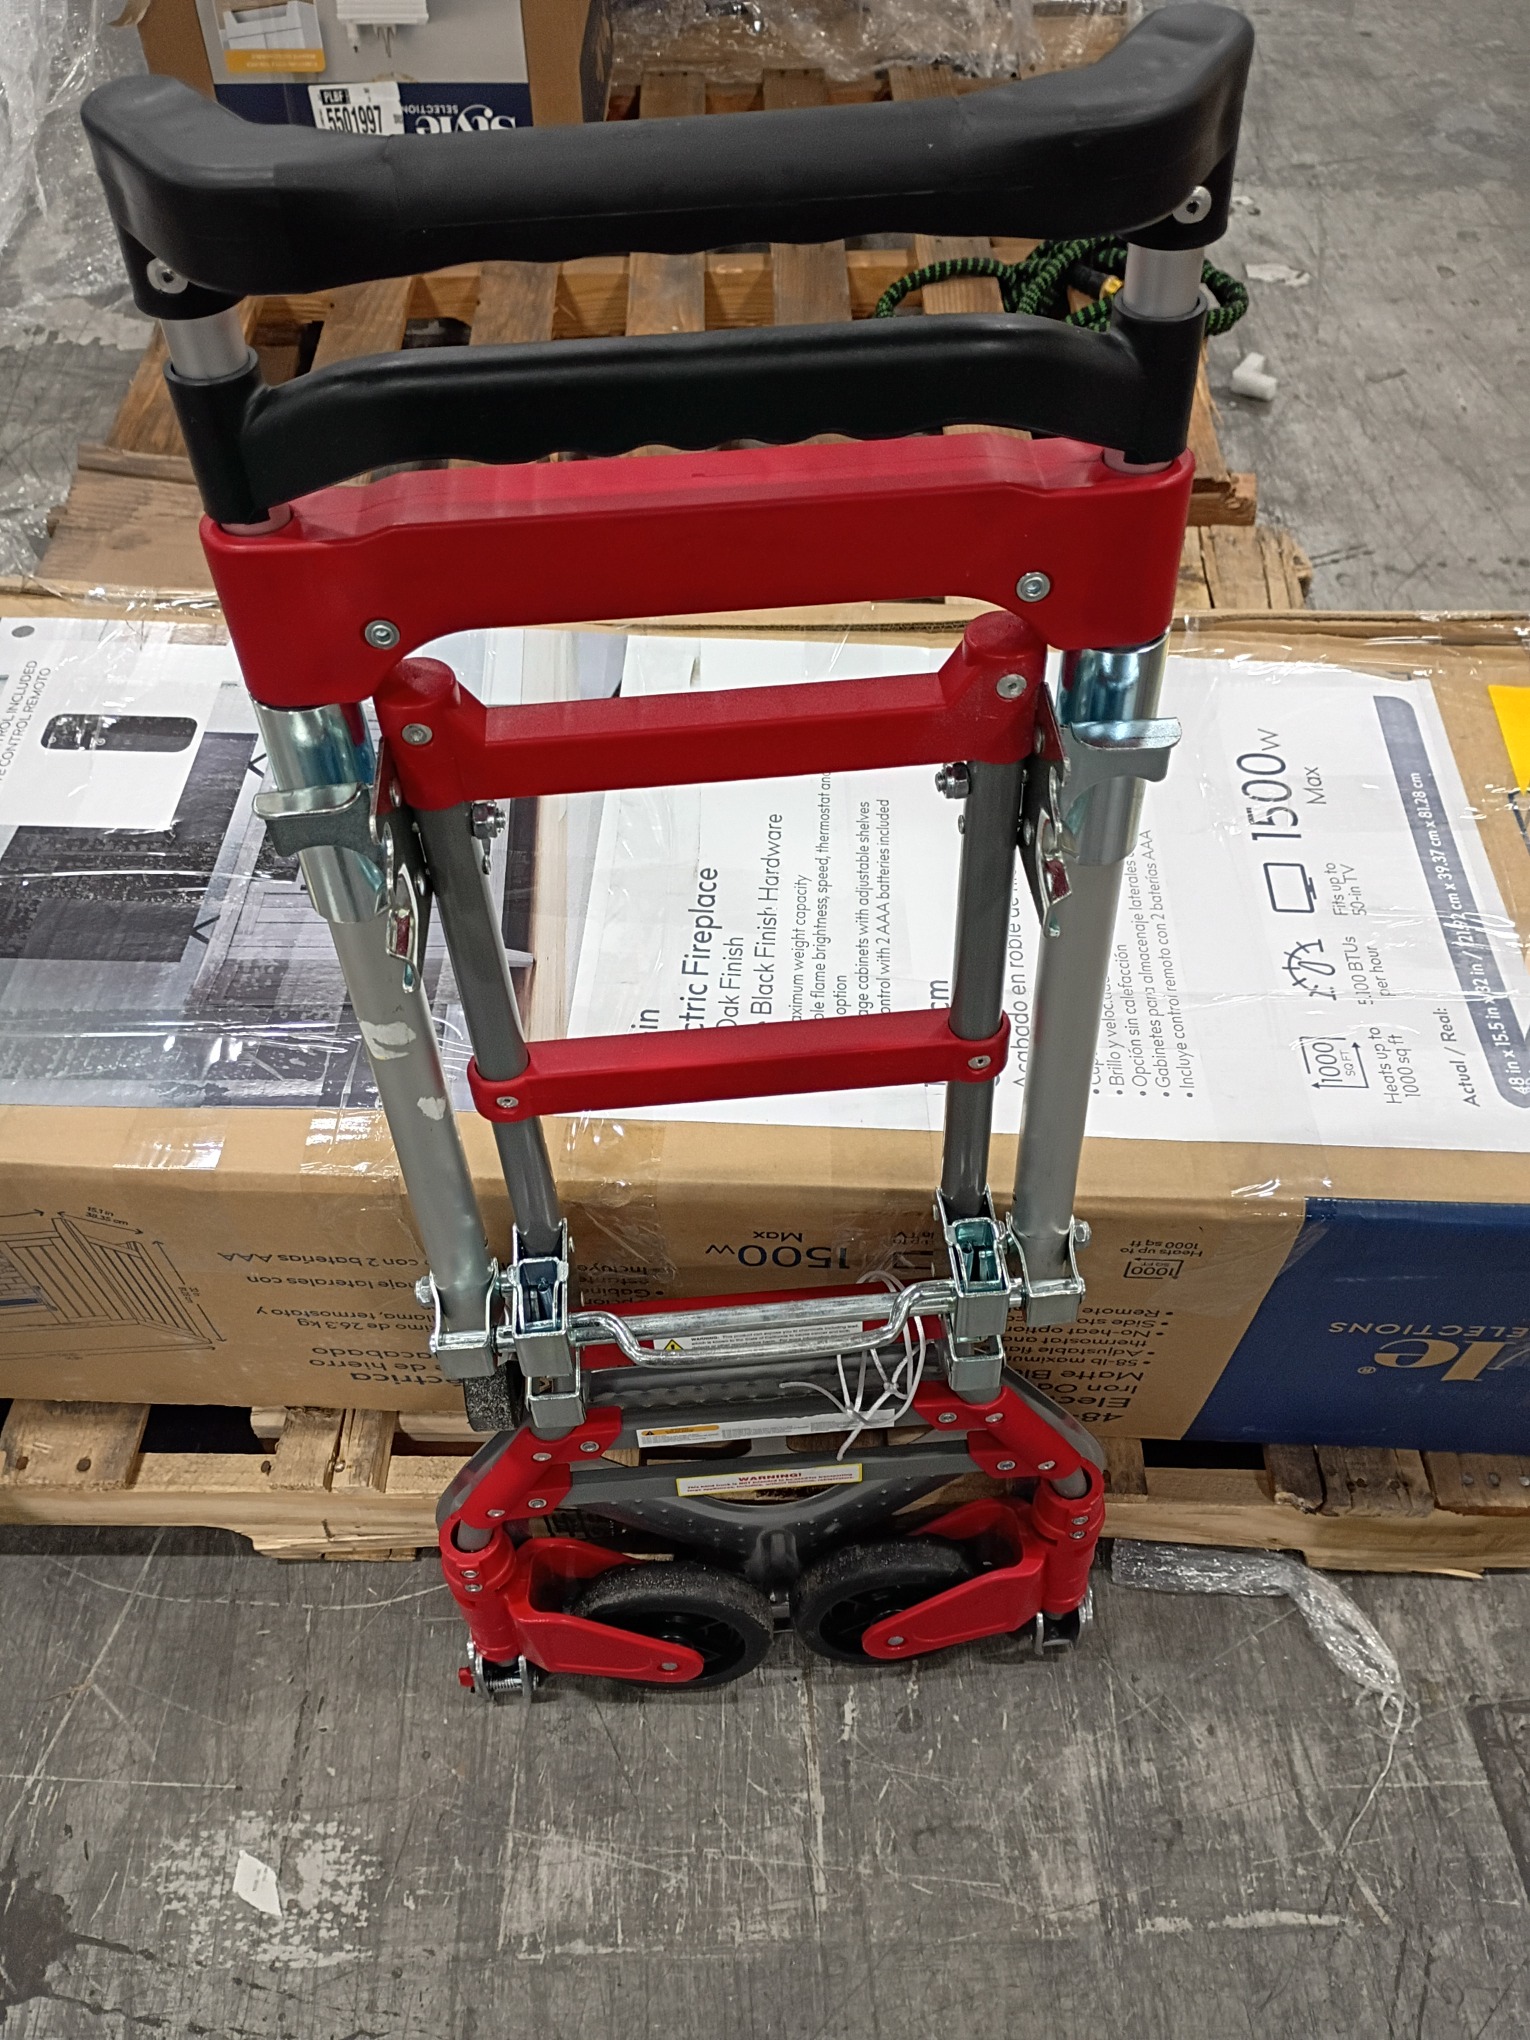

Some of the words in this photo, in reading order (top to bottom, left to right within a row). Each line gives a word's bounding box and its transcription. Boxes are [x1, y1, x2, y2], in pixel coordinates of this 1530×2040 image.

[6, 660, 38, 714] INCLUDED
[23, 667, 51, 713] REMOTO
[1303, 766, 1327, 804] Max
[1410, 772, 1424, 789] cm
[1412, 790, 1433, 818] 81.28
[815, 793, 830, 853] thermostat
[855, 801, 870, 843] shelves
[876, 799, 890, 846] included
[1425, 820, 1437, 829] x
[1138, 829, 1155, 861] AAA
[1428, 830, 1442, 847] cm
[757, 814, 783, 901] Hardware
[1430, 849, 1453, 880] 39.37
[815, 855, 833, 893] speed,
[855, 845, 874, 906] adjustable
[876, 848, 890, 899] batteries
[1324, 862, 1337, 874] to
[1339, 863, 1358, 884] TV
[1124, 860, 1142, 910] laterales
[1145, 863, 1164, 910] baterías
[1329, 877, 1346, 891] up
[1445, 883, 1457, 891] x
[794, 874, 812, 926] capacity
[1331, 894, 1349, 916] Fits
[1348, 886, 1367, 916] 50-in
[1448, 893, 1463, 910] cm
[681, 868, 723, 976] Fireplace
[812, 896, 832, 960] brightness,
[855, 908, 869, 935] with
[876, 902, 891, 936] AAA
[754, 906, 777, 958] Finish
[1156, 923, 1169, 945] con
[791, 928, 810, 971] weight
[876, 937, 891, 948] 2
[1131, 913, 1154, 984] almacenaje
[719, 937, 744, 989] Finish
[1342, 936, 1364, 971] BTUs
[1366, 946, 1385, 973] hour
[855, 938, 869, 990] cabinets
[876, 951, 890, 976] with
[1158, 948, 1177, 992] remoto
[1469, 963, 1485, 976] in
[810, 963, 826, 998] flame
[1010, 973, 1026, 995] en
[1114, 944, 1137, 1014] calefacción
[1375, 975, 1397, 997] per
[750, 964, 775, 1014] Black
[833, 975, 851, 1015] option
[1485, 1007, 1501, 1019] in
[1125, 1018, 1140, 1035] sin
[1368, 1027, 1382, 1040] to
[1433, 1008, 1457, 1042] Real:
[1488, 1022, 1511, 1047] 15.5
[1109, 1039, 1126, 1049] y
[1391, 1034, 1406, 1045] ft
[1149, 1019, 1171, 1088] Gabinetes
[1339, 1049, 1353, 1061] FT
[1375, 1042, 1389, 1060] up
[1396, 1047, 1412, 1064] sq
[1444, 1046, 1466, 1057] /
[1503, 1050, 1515, 1058] x
[1107, 1051, 1125, 1086] Brillo
[1128, 1039, 1152, 1087] Opción
[1176, 1042, 1195, 1088] Incluye
[1312, 1042, 1343, 1083] 1000
[1344, 1061, 1356, 1077] SQ
[1505, 1061, 1522, 1073] in
[1378, 1062, 1402, 1104] Heats
[1400, 1066, 1422, 1097] 1000
[1450, 1060, 1480, 1107] Actual
[753, 1231, 803, 1242] Max
[1128, 1240, 1143, 1248] ft
[1145, 1240, 1163, 1248] sq
[1164, 1241, 1199, 1249] 1000
[217, 1252, 273, 1264] AAA
[1120, 1248, 1135, 1256] to
[1138, 1246, 1156, 1256] up
[1159, 1248, 1203, 1257] Heats
[366, 1257, 380, 1267] 2
[383, 1258, 419, 1267] con
[246, 1276, 283, 1285] con
[1130, 1267, 1177, 1277] 1000
[286, 1277, 373, 1289] laterales
[256, 1306, 268, 1315] y
[271, 1308, 375, 1320] termostato
[1082, 1307, 1160, 1317] Remote
[297, 1318, 320, 1330] kg
[325, 1321, 363, 1331] 26.3
[367, 1323, 390, 1331] de
[1068, 1327, 1151, 1337] No-heat
[1111, 1319, 1156, 1328] Side
[1038, 1346, 1143, 1357] Adjustable
[1042, 1337, 1148, 1347] thermostat
[309, 1360, 387, 1372] hierro
[1090, 1358, 1139, 1367] 58-lb
[1060, 1370, 1144, 1381] Matte
[1087, 1384, 1138, 1395] Iron
[738, 1472, 802, 1482] WARNING!
